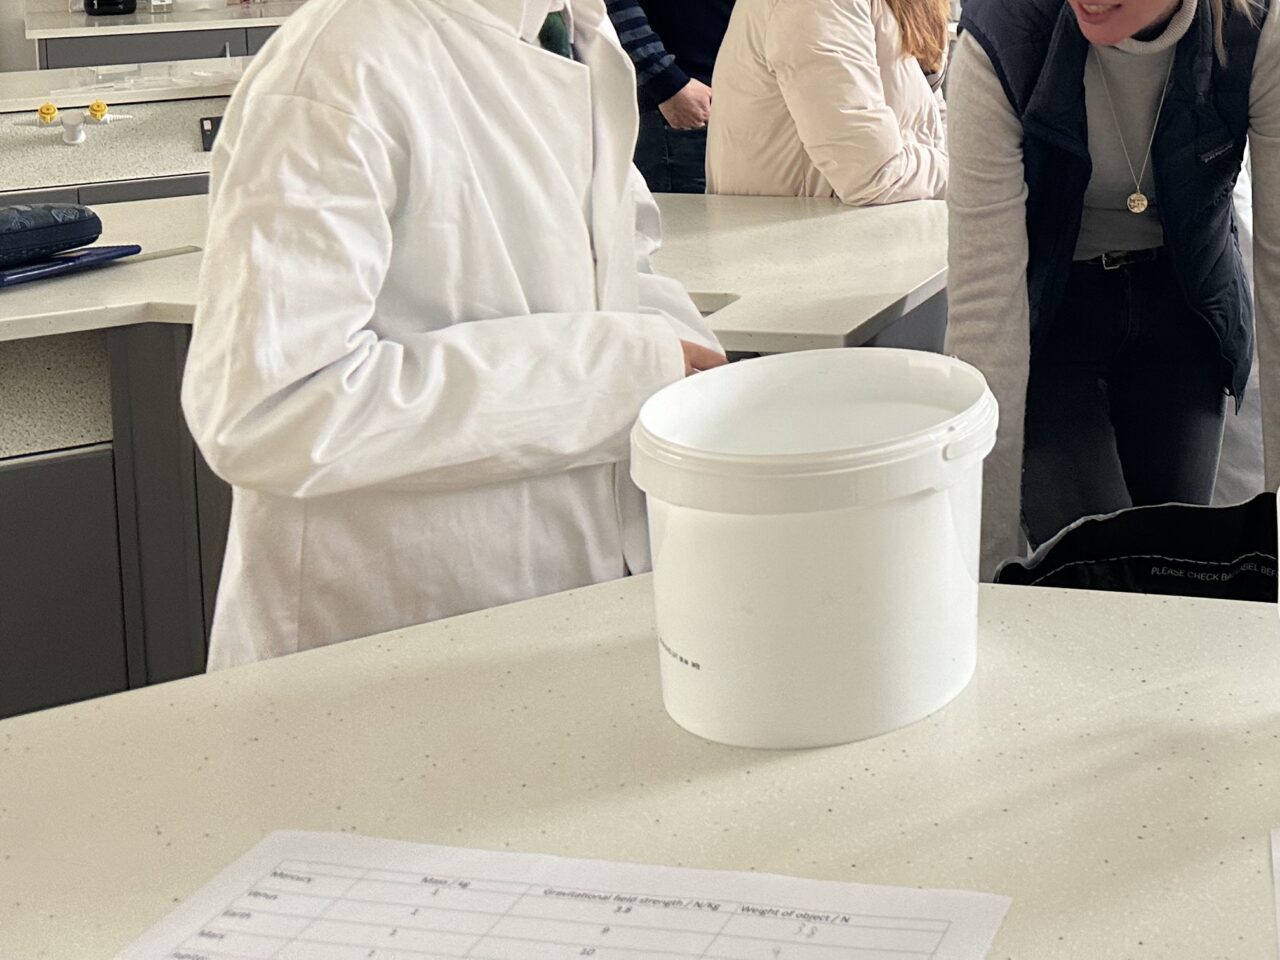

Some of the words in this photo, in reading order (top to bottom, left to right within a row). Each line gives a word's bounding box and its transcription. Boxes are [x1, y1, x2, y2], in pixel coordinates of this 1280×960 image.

[1151, 566, 1185, 578] PLEASE
[1187, 570, 1219, 582] CHECK
[543, 888, 611, 901] Gravitational
[613, 894, 638, 904] field
[639, 896, 684, 908] strength
[694, 900, 721, 912] N/kg
[741, 904, 779, 917] Weight
[780, 909, 796, 917] of
[796, 912, 831, 922] object
[840, 915, 851, 923] N
